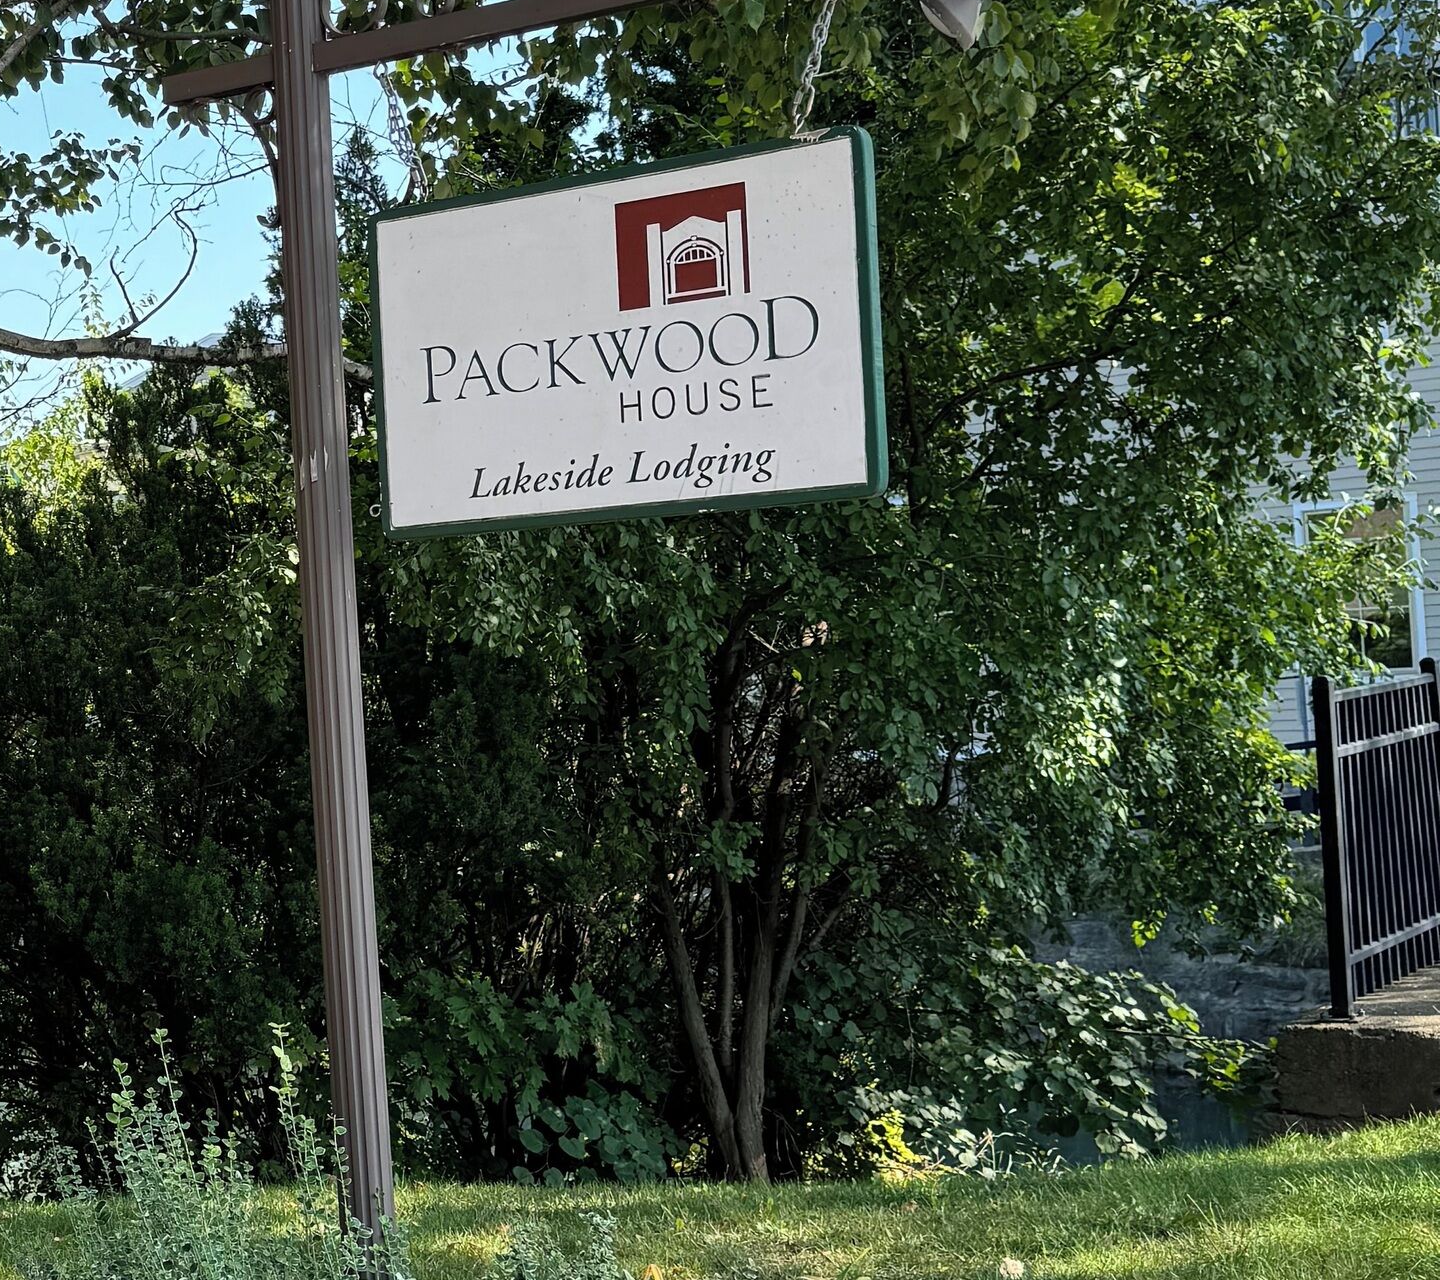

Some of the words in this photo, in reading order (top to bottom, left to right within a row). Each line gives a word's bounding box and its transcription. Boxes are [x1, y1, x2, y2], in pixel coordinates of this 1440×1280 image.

[420, 295, 819, 404] PACKWOOD
[619, 373, 774, 423] HOUSE
[469, 454, 614, 499] Lakeside
[626, 442, 777, 489] Lodging
